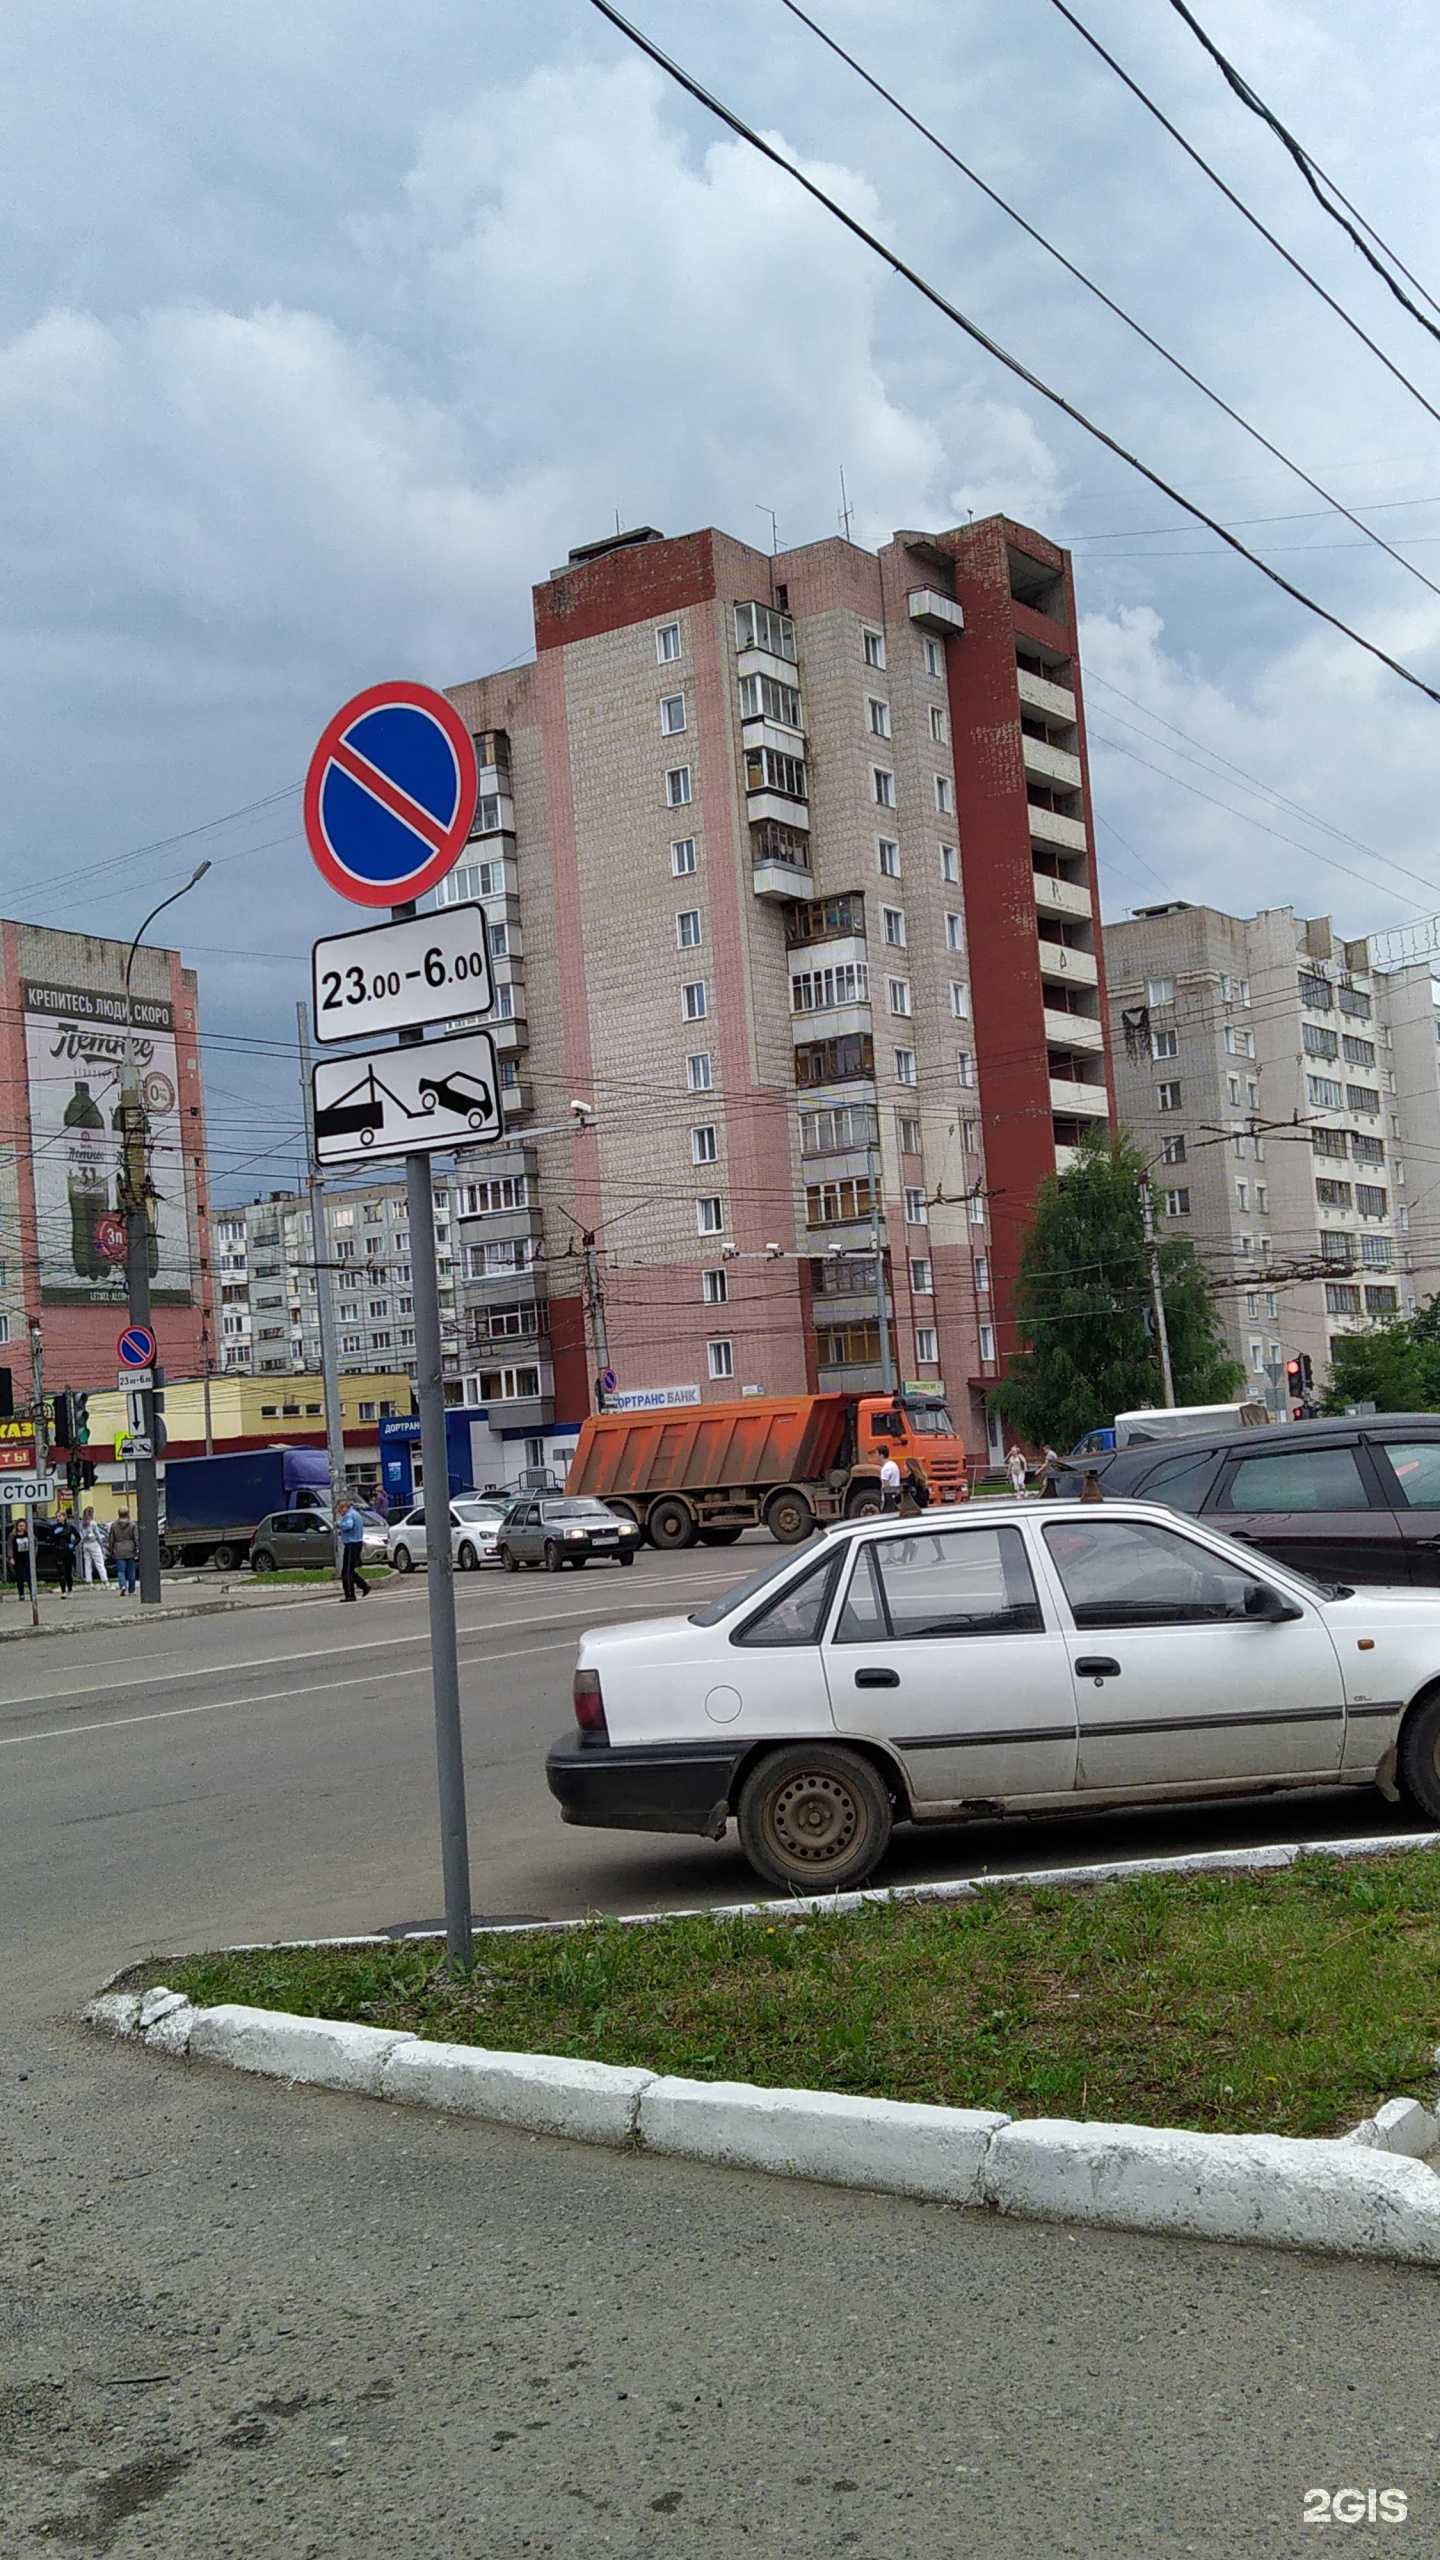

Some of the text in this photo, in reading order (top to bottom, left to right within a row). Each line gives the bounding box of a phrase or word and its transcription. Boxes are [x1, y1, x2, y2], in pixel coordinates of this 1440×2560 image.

[321, 947, 483, 1010] 23.00-6.00
[28, 988, 93, 1013] КРЕПИТЕСЬ
[134, 1004, 170, 1025] СКОРО
[615, 1393, 666, 1409] ОРТРАНС
[667, 1388, 698, 1404] БАНК
[385, 1421, 421, 1434] ДОРТРАН
[3, 1483, 48, 1499] СТОП
